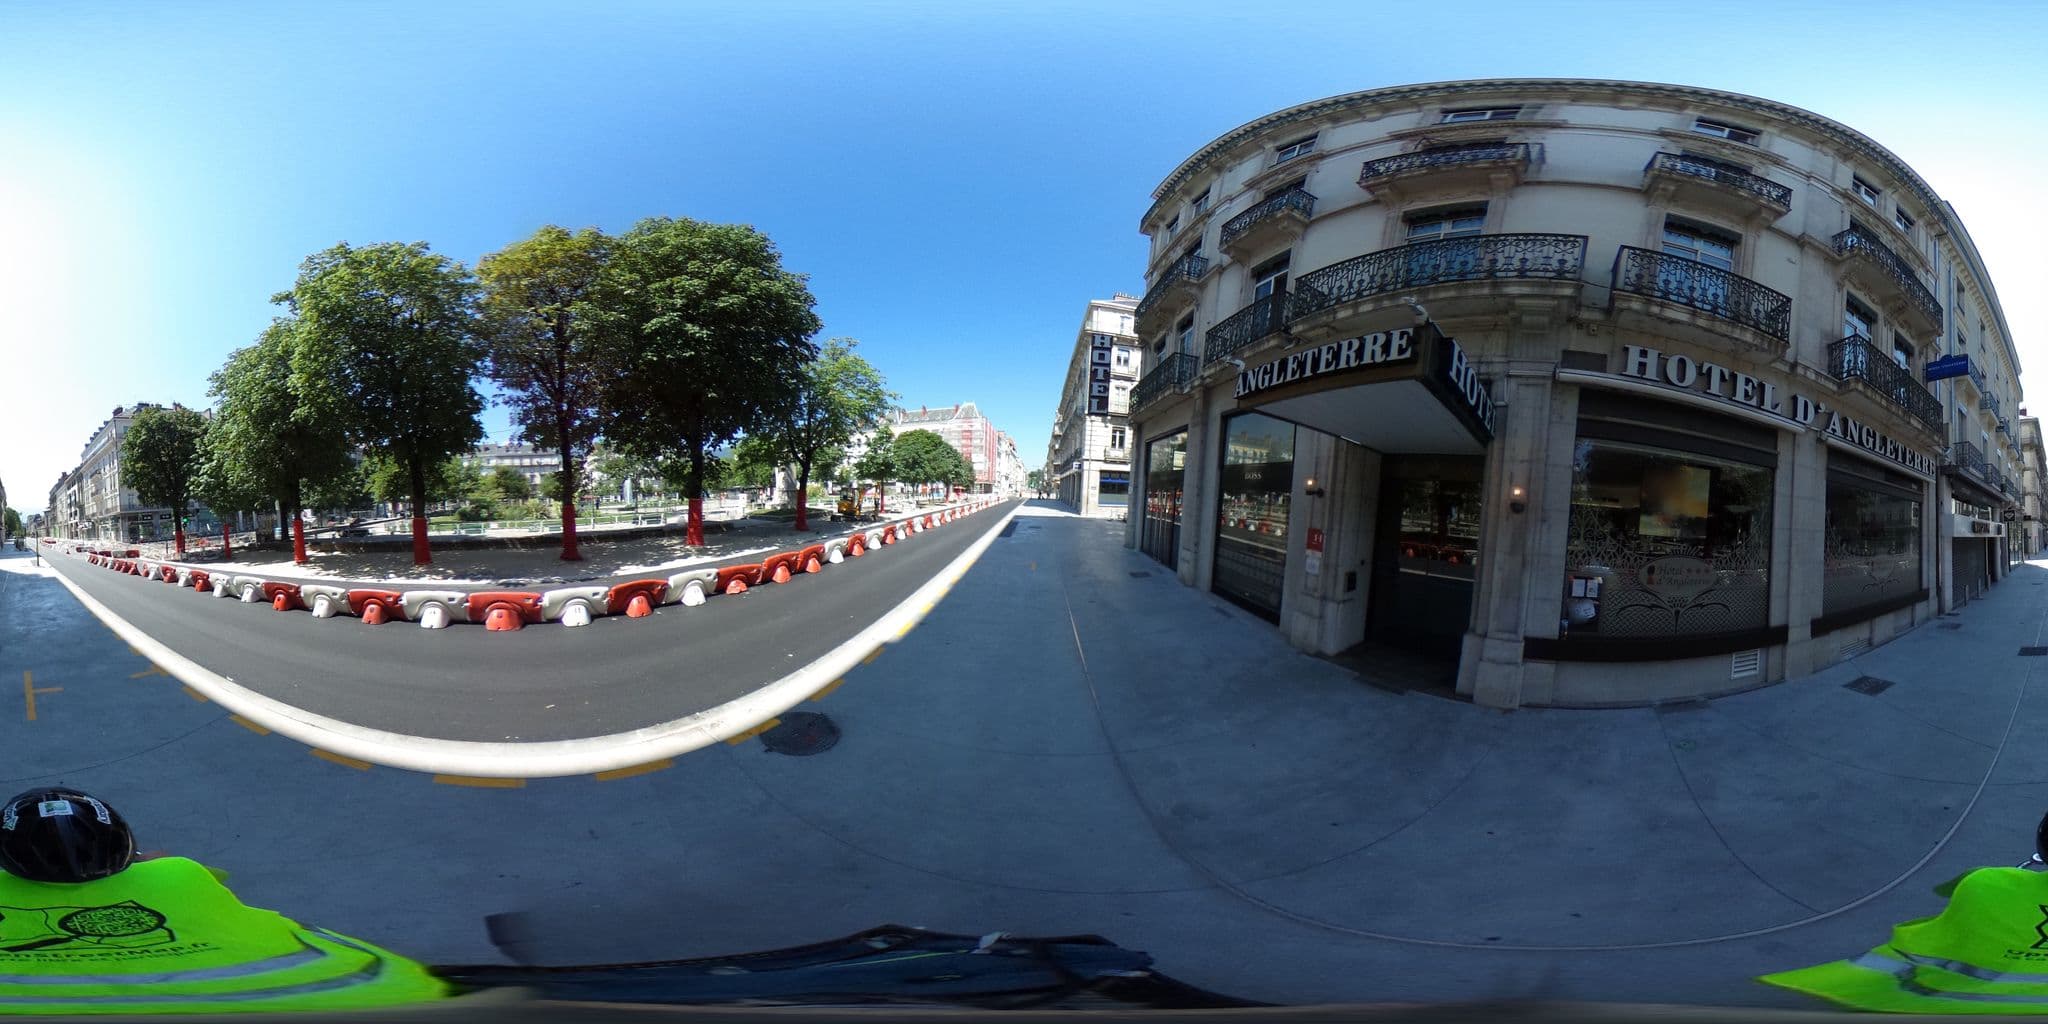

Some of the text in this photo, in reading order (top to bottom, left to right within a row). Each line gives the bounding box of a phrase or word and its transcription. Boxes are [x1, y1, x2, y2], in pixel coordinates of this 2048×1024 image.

[1090, 334, 1112, 414] HOTEL
[1233, 327, 1414, 399] ANGLETERRE
[1622, 344, 1783, 415] HOTEL
